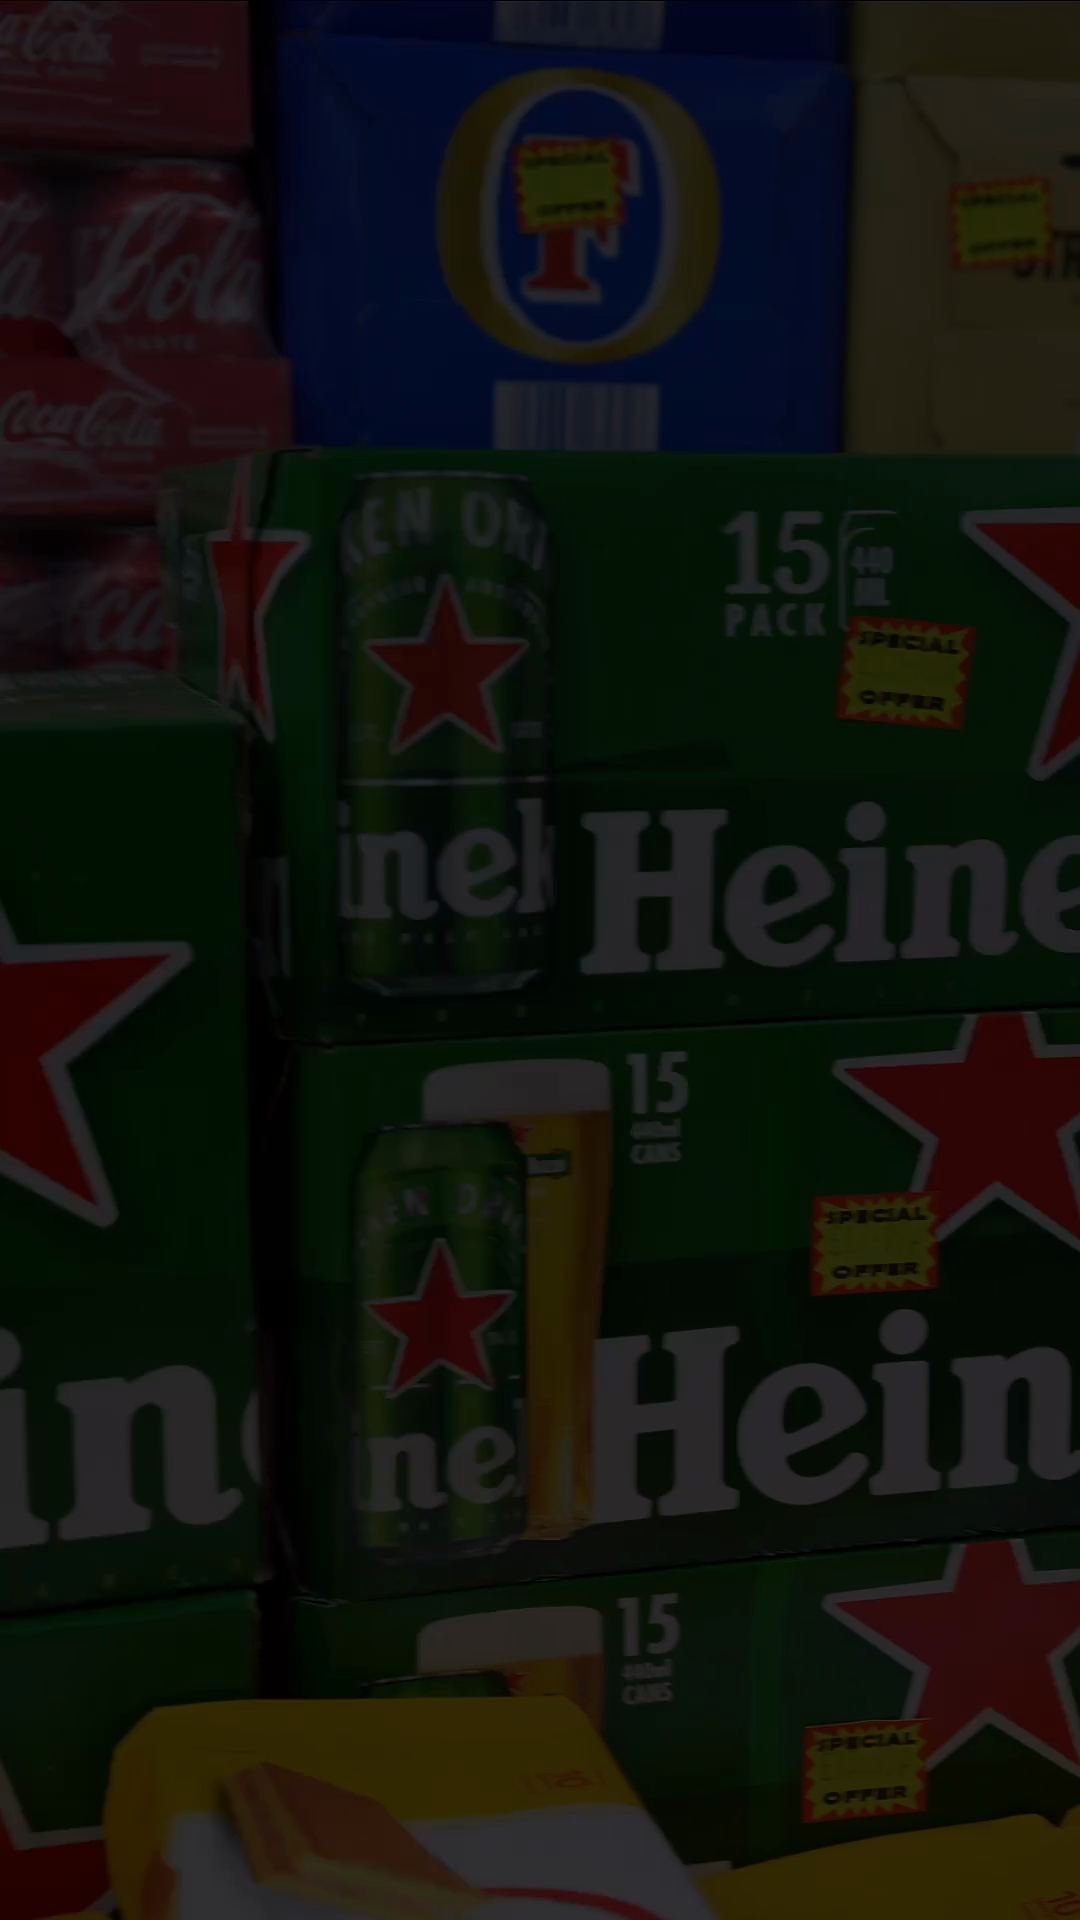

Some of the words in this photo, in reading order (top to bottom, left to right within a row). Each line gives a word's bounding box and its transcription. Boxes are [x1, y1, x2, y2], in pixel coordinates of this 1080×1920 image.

[721, 510, 830, 595] 15
[850, 545, 896, 575] 440
[724, 602, 827, 638] PACK
[858, 630, 960, 656] SPECIAL
[858, 689, 945, 711] OFFER
[625, 1050, 690, 1115] 15
[825, 1207, 928, 1225] SPECIAL
[833, 1262, 919, 1279] OFFER
[594, 1309, 1080, 1524] Hein
[0, 1324, 262, 1549] in
[616, 1592, 681, 1657] 15
[817, 1732, 917, 1752] SPECIAL
[823, 1785, 907, 1805] OFFER
